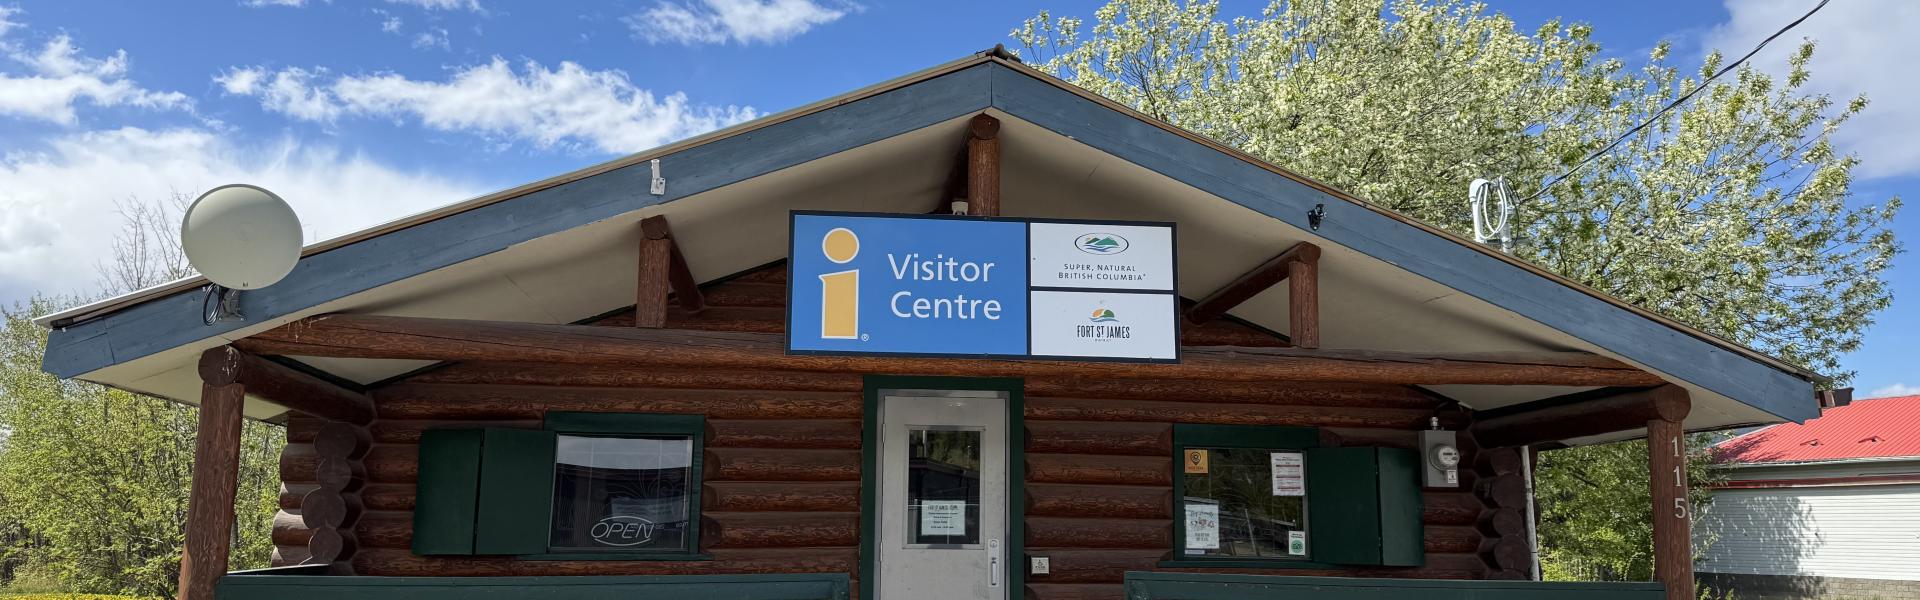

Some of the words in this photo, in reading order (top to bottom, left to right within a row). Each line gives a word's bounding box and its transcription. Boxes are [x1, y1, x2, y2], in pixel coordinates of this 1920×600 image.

[887, 253, 995, 282] Visitor
[1064, 263, 1094, 271] SUPER,
[1097, 264, 1136, 272] NATURAL
[1058, 272, 1093, 280] BRITISH
[890, 290, 1002, 320] Centre
[1077, 325, 1094, 338] FORT
[1106, 326, 1130, 339] JAMES
[591, 522, 655, 539] OPEN
